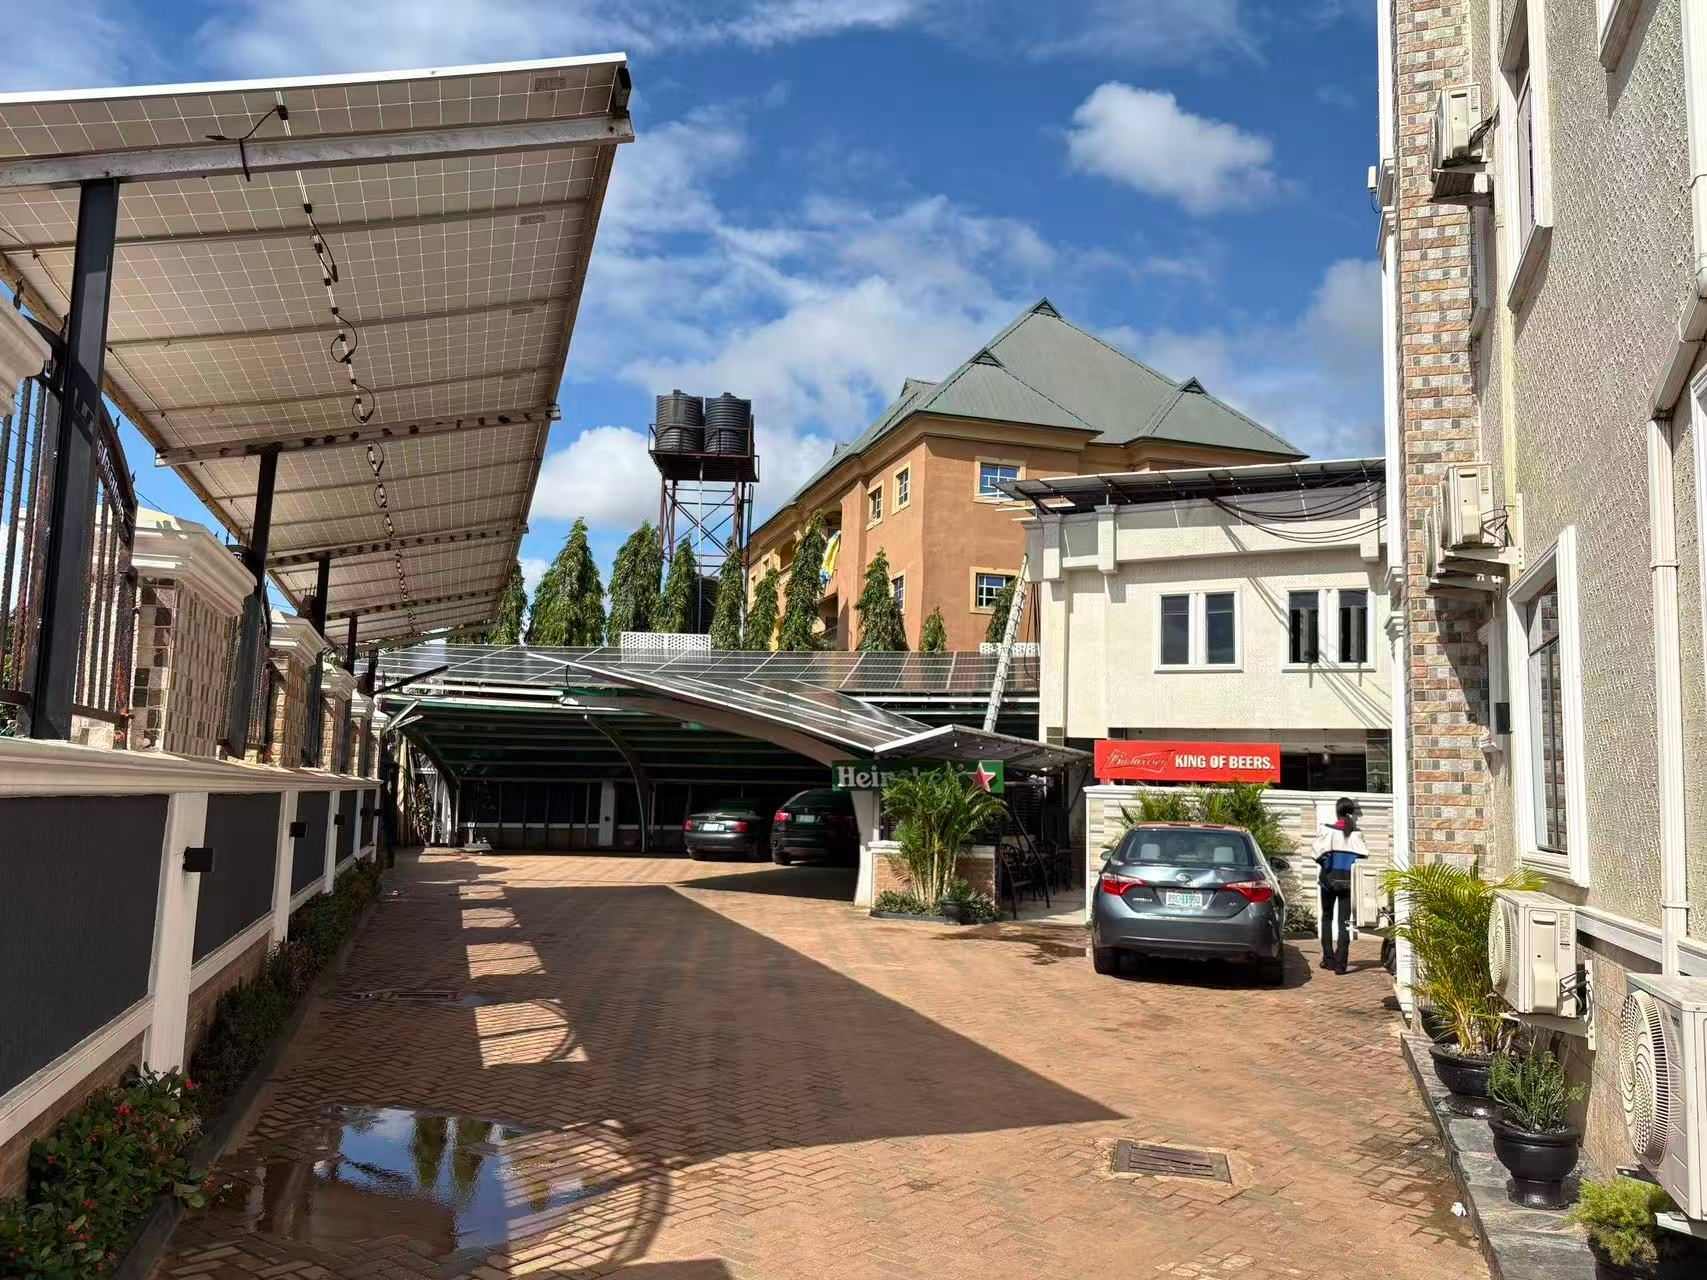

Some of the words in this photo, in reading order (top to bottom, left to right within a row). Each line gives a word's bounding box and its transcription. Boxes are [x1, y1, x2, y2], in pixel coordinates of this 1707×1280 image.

[1175, 754, 1206, 768] KING
[1209, 755, 1227, 769] OF
[1229, 755, 1275, 769] BEERS.
